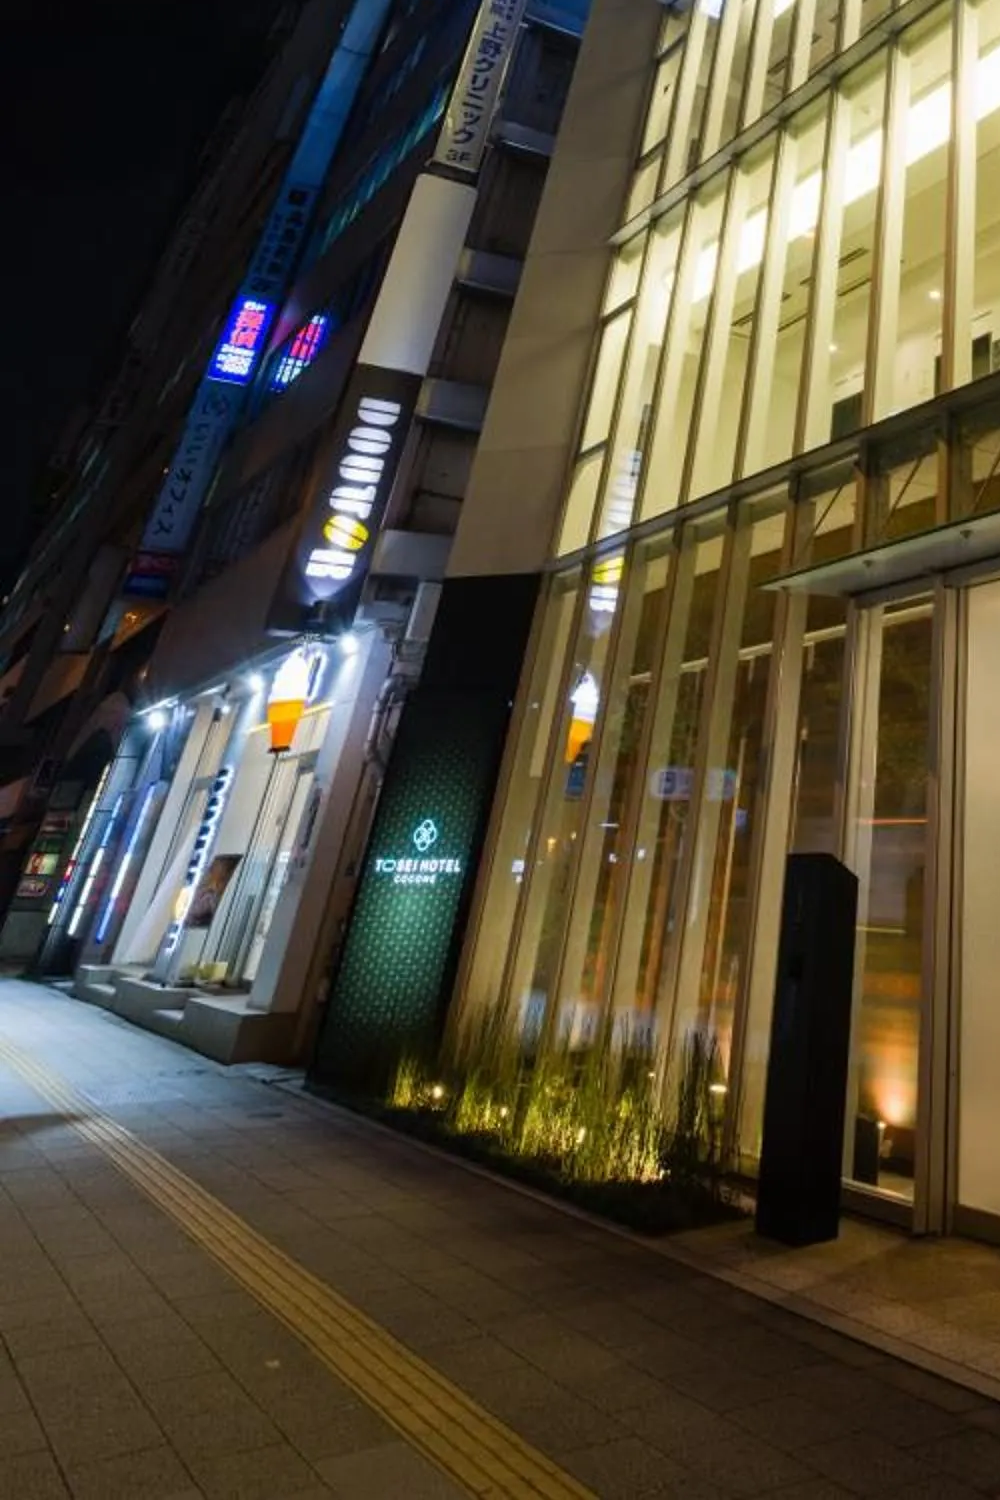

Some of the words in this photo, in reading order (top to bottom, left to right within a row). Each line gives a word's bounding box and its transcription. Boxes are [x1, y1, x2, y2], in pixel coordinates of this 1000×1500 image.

[305, 396, 401, 580] DOUTOR
[375, 859, 418, 873] TOSEI
[419, 859, 461, 873] HOTEL
